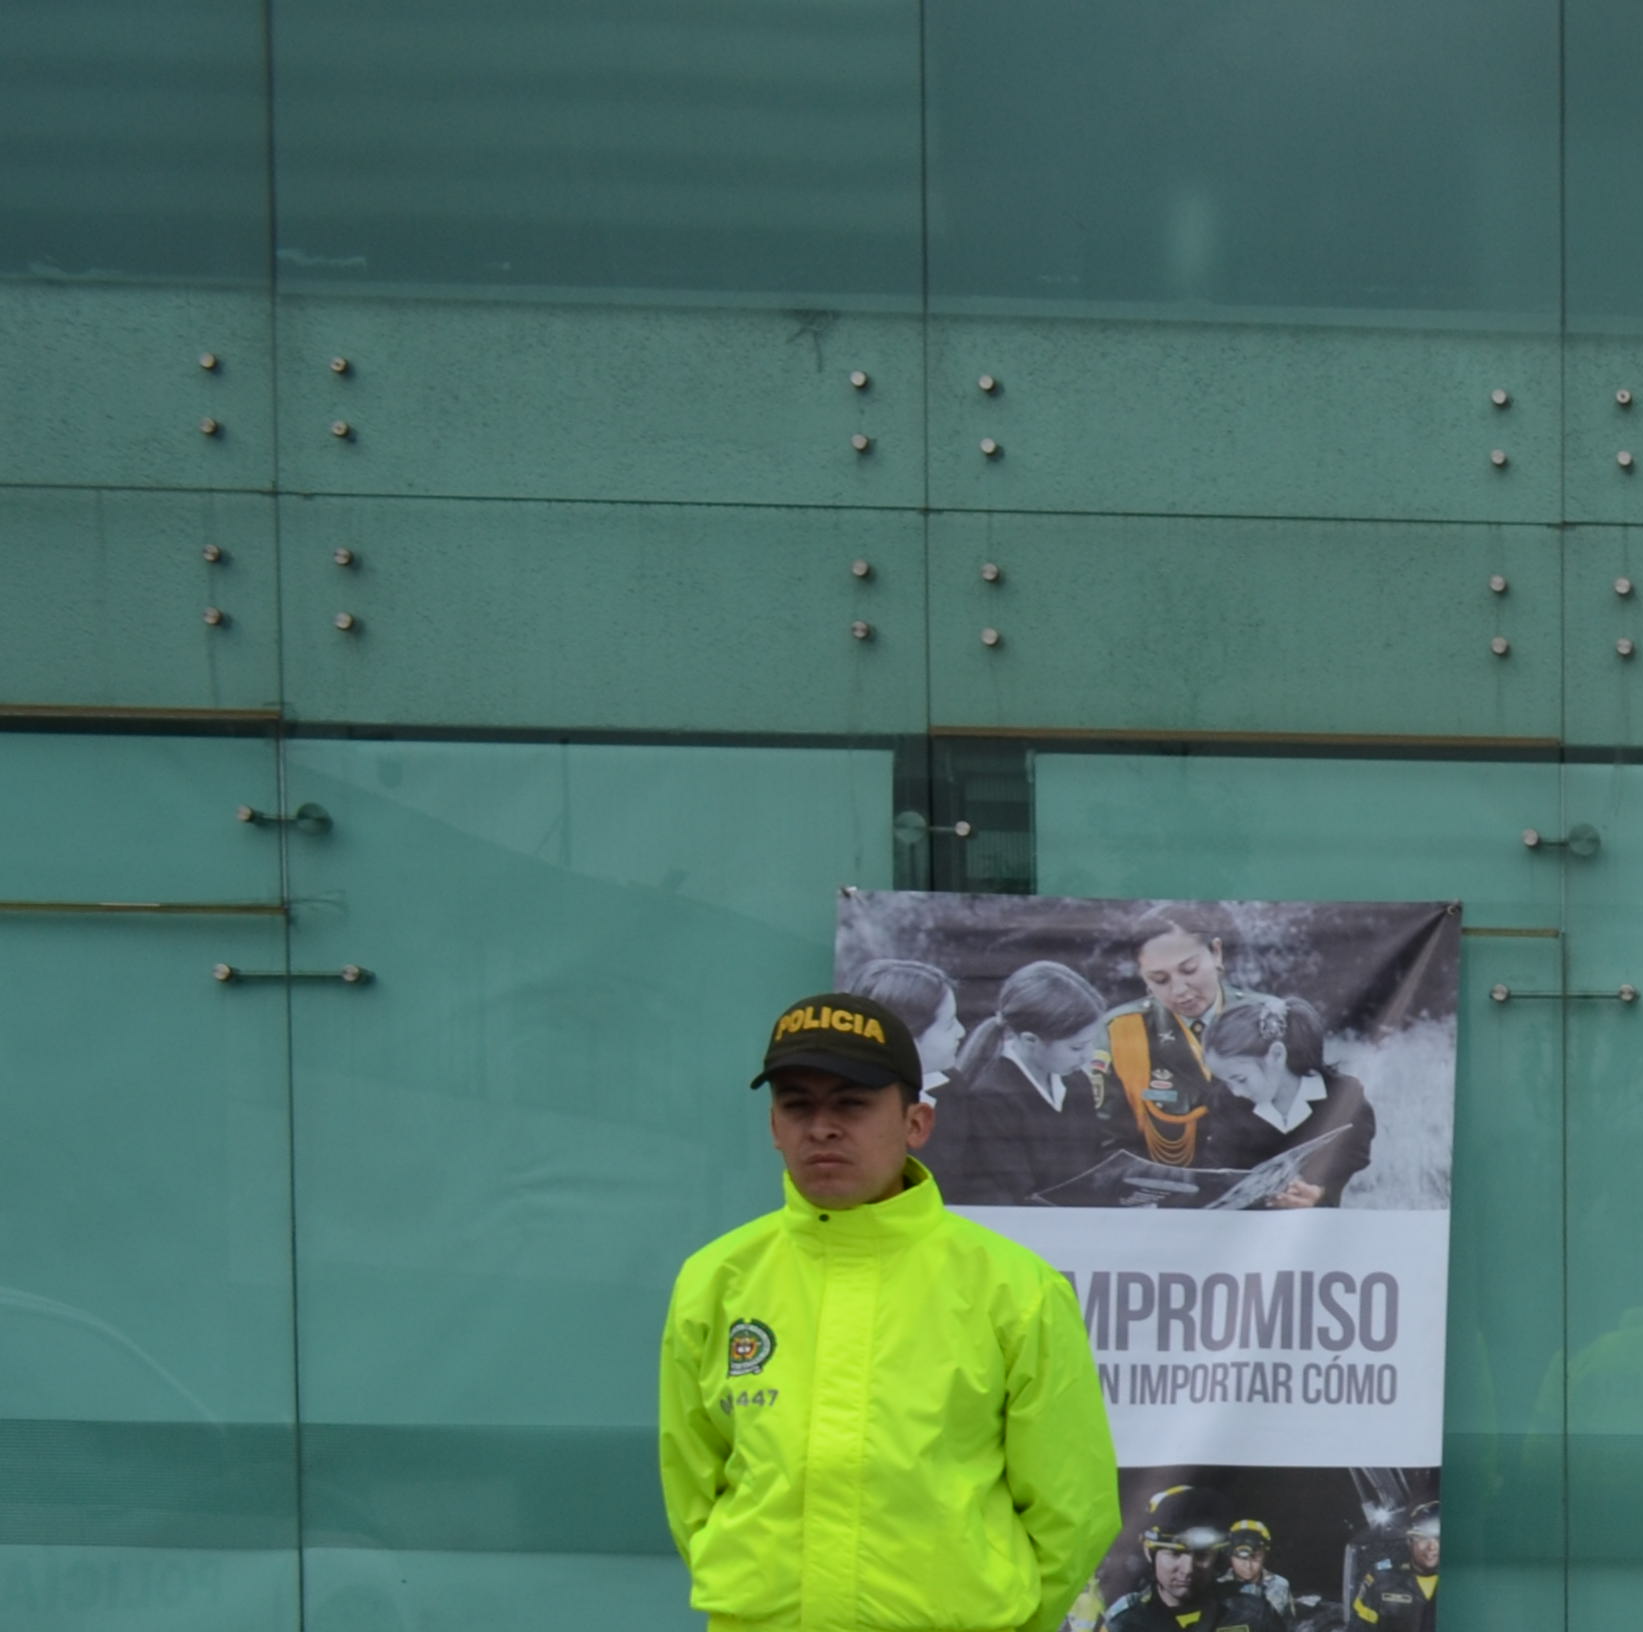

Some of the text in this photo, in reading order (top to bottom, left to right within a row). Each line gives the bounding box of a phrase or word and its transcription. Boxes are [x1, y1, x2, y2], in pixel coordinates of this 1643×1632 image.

[775, 1005, 886, 1045] POLICIA
[1060, 1270, 1399, 1352] MPROMISO
[1128, 1361, 1293, 1406] IMPORTAR
[1301, 1355, 1398, 1406] CÓMO
